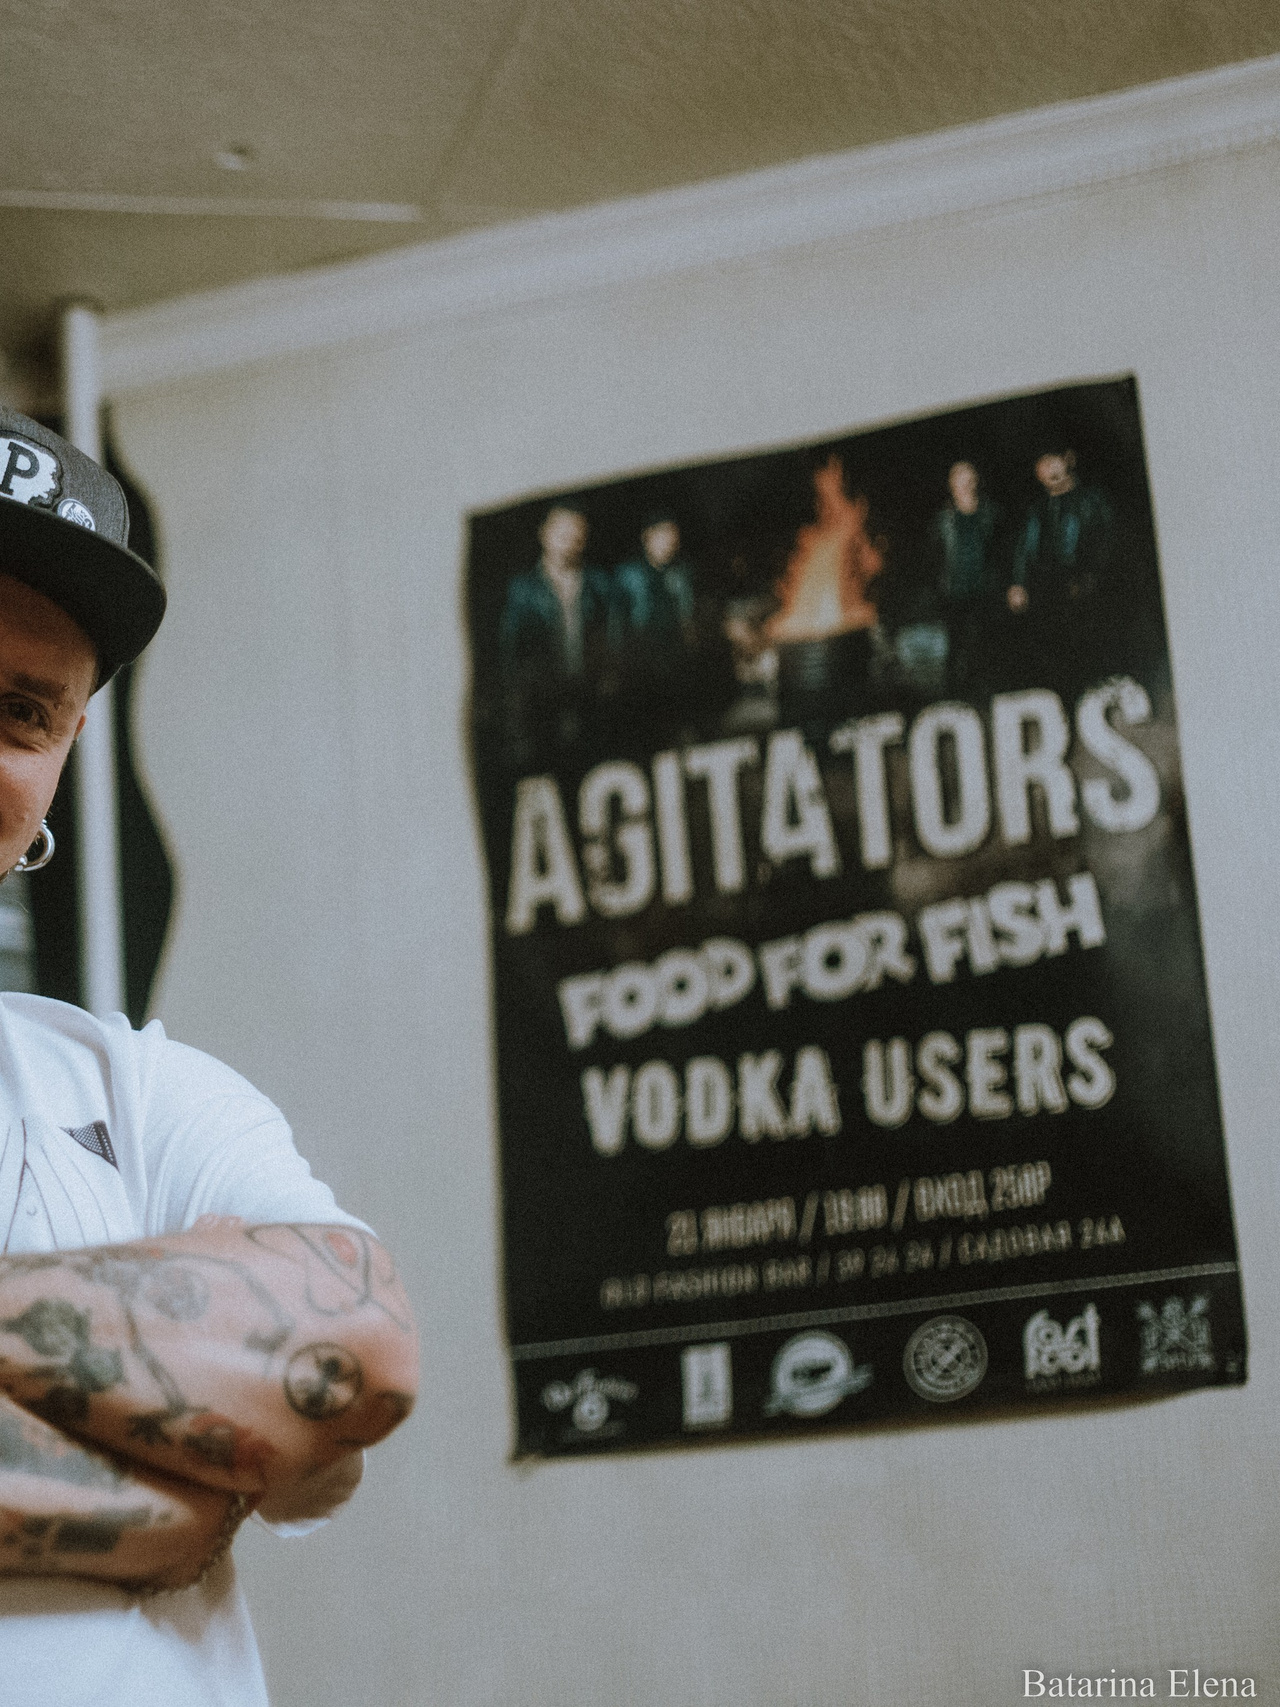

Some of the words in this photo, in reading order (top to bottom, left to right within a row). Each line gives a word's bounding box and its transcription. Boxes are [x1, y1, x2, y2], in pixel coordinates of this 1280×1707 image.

[505, 675, 1160, 936] AGITATORS
[557, 936, 757, 1050] FOOD
[756, 911, 915, 1011] FOR
[917, 871, 1106, 986] FISH
[580, 1044, 840, 1157] VODKA
[862, 1016, 1117, 1129] USERS
